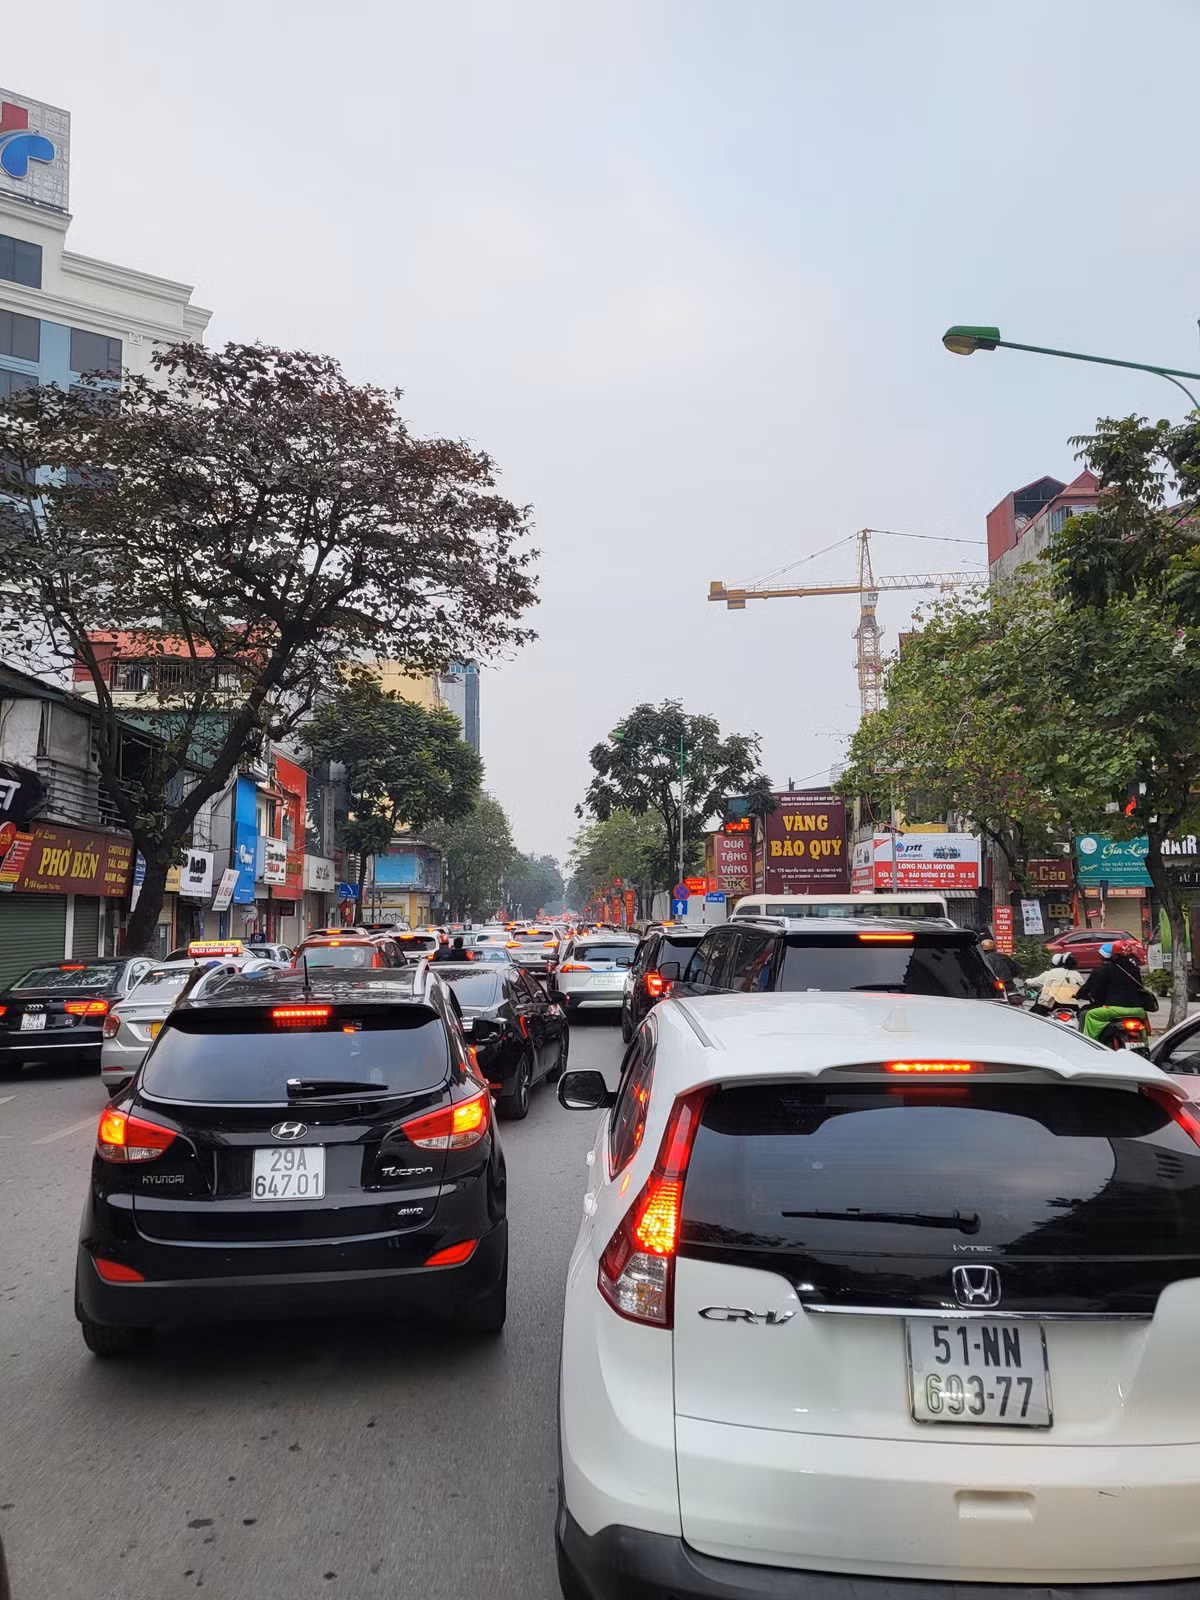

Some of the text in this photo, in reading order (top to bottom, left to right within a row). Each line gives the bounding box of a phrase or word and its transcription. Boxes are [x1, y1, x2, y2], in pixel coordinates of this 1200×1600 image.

[782, 811, 829, 832] VÀNG
[723, 838, 744, 848] QUÀ
[771, 835, 805, 857] BẢO
[809, 835, 842, 860] QUÝ
[905, 844, 923, 853] ptt
[1160, 834, 1198, 855] HAIR
[38, 839, 73, 877] PHỞ
[720, 850, 747, 862] TẶNG
[720, 863, 748, 874] VÀNG
[878, 870, 889, 878] SỬA
[908, 870, 920, 878] BẢO
[920, 870, 939, 878] DƯỠNG
[1039, 866, 1066, 881] Cáo
[270, 1149, 308, 1172] 29A
[142, 1174, 185, 1184] HYUNDAI
[254, 1172, 322, 1198] 647.01
[697, 1305, 798, 1325] CR-V
[933, 1325, 1023, 1368] 51-NN
[925, 1373, 1034, 1418] 693-77
